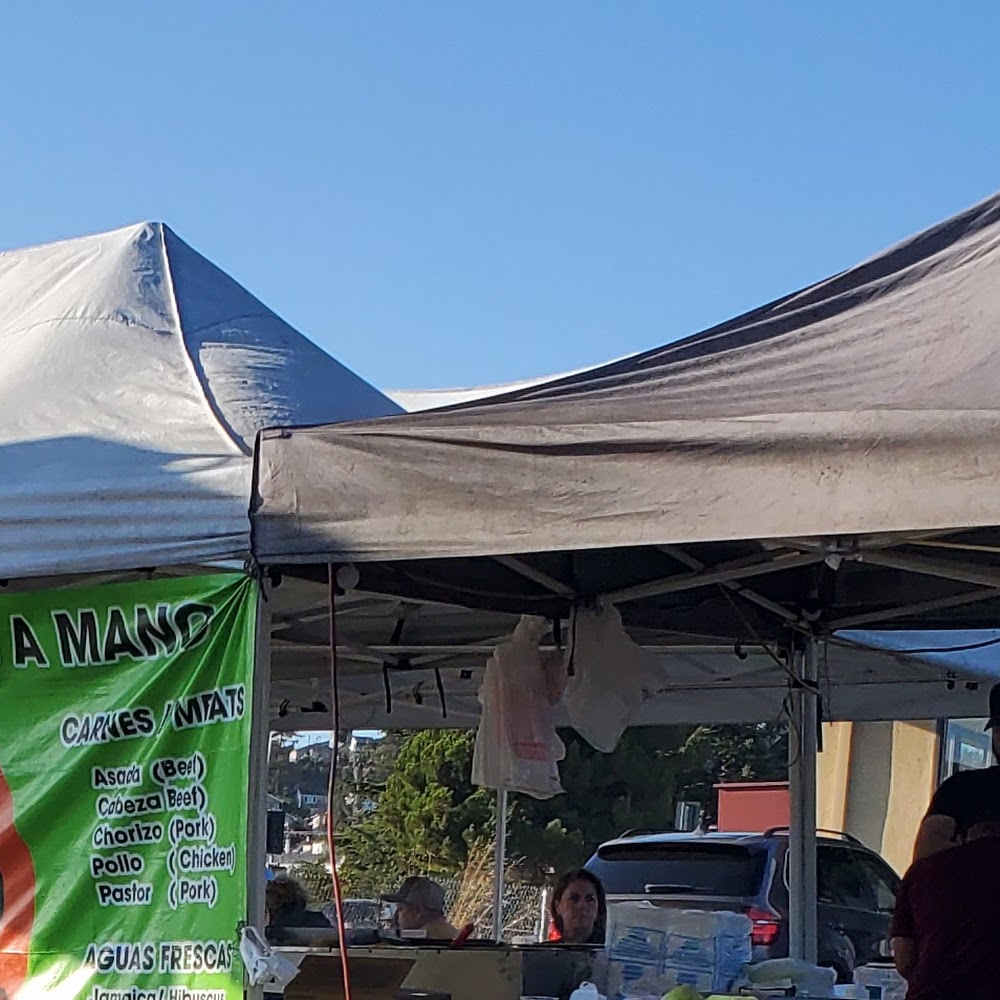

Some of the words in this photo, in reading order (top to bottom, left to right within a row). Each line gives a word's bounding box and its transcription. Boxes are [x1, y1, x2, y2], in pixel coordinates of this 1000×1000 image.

[12, 615, 48, 667] A
[62, 708, 154, 744] CARNES
[94, 764, 141, 786] Asada
[152, 754, 204, 784] (Beef)
[98, 794, 161, 816] Cabeza
[93, 822, 162, 847] Chorizo
[170, 818, 215, 844] (Pork)
[92, 854, 142, 875] Pollo
[99, 882, 151, 903] Pastor
[85, 945, 154, 971] AGUAS
[161, 943, 233, 970] FRESCAS
